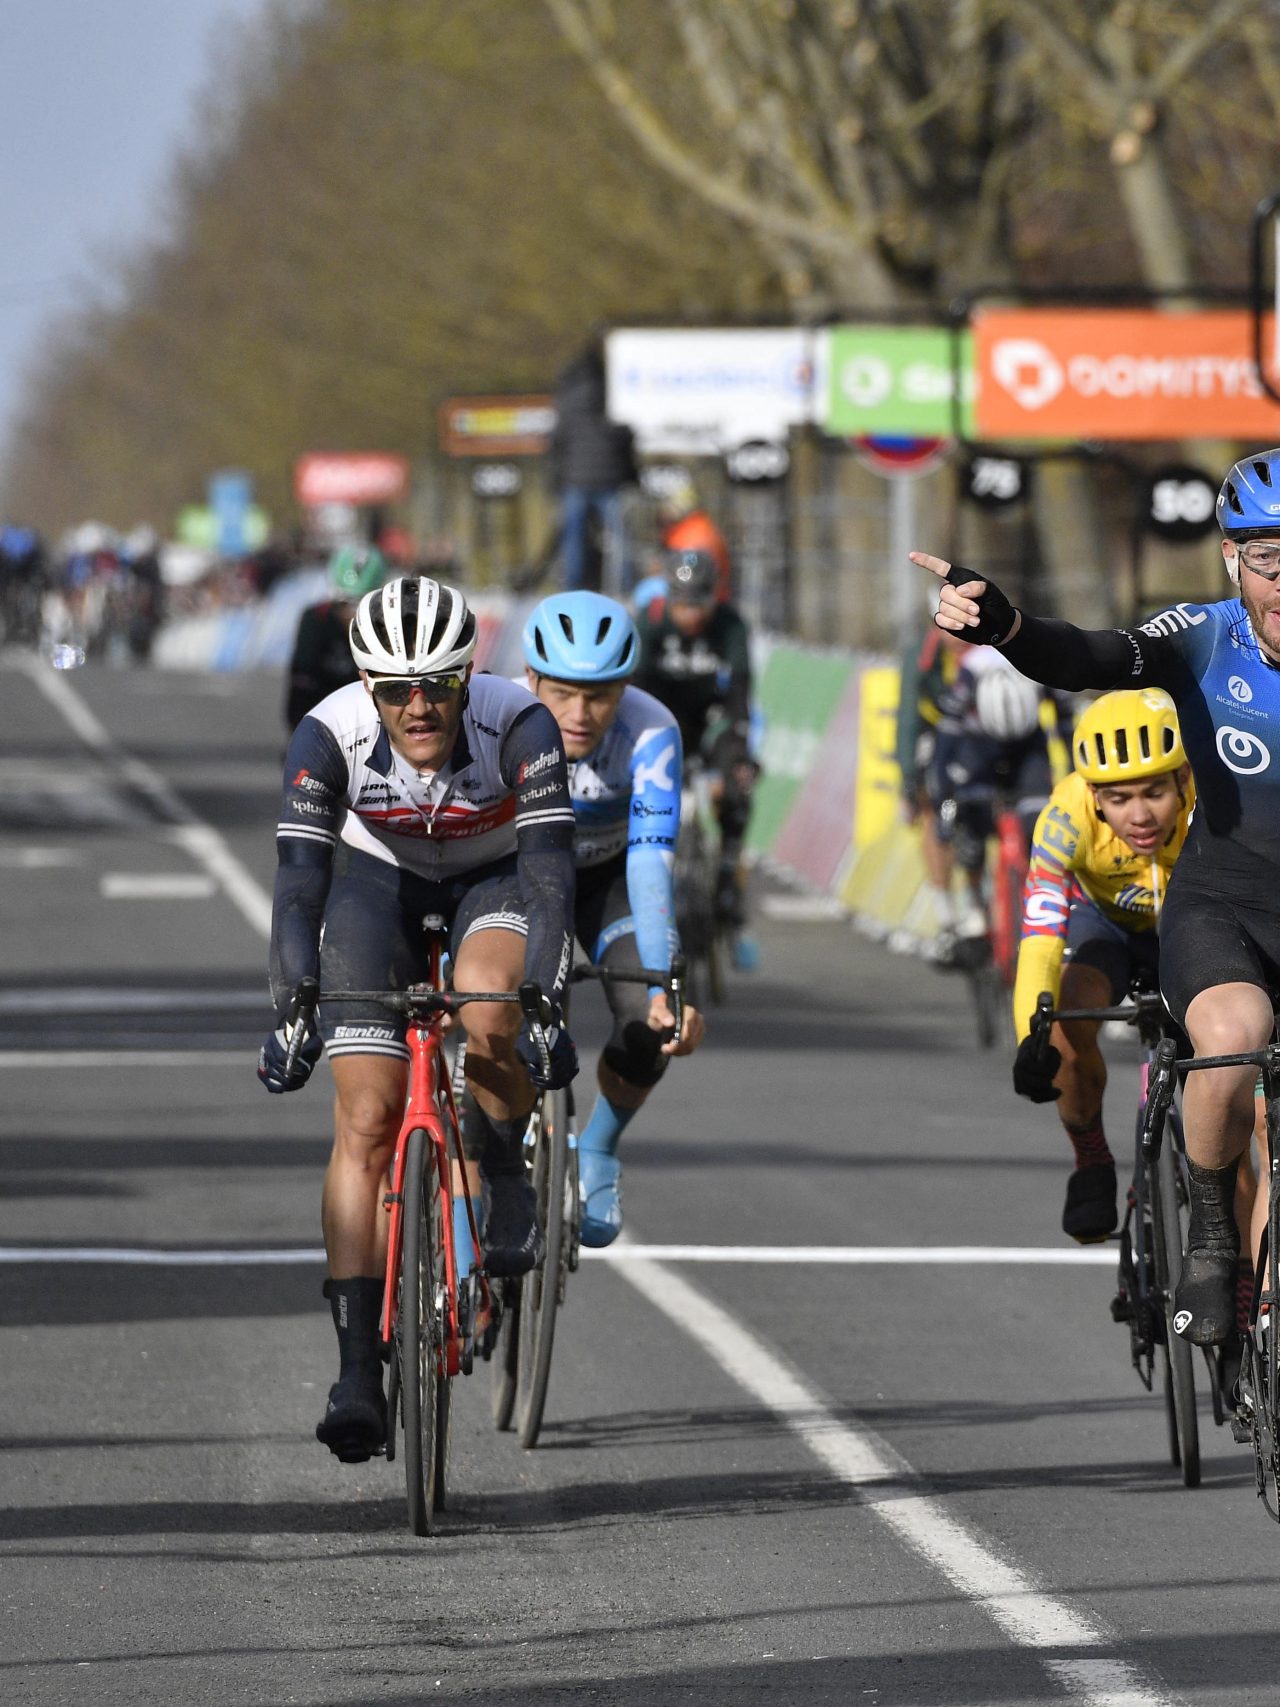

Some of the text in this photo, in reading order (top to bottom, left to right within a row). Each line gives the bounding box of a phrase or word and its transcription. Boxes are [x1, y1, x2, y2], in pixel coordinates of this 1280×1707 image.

[1152, 480, 1216, 524] 50
[1140, 602, 1208, 638] BMC
[345, 734, 371, 753] TRE
[334, 1025, 396, 1040] Santini
